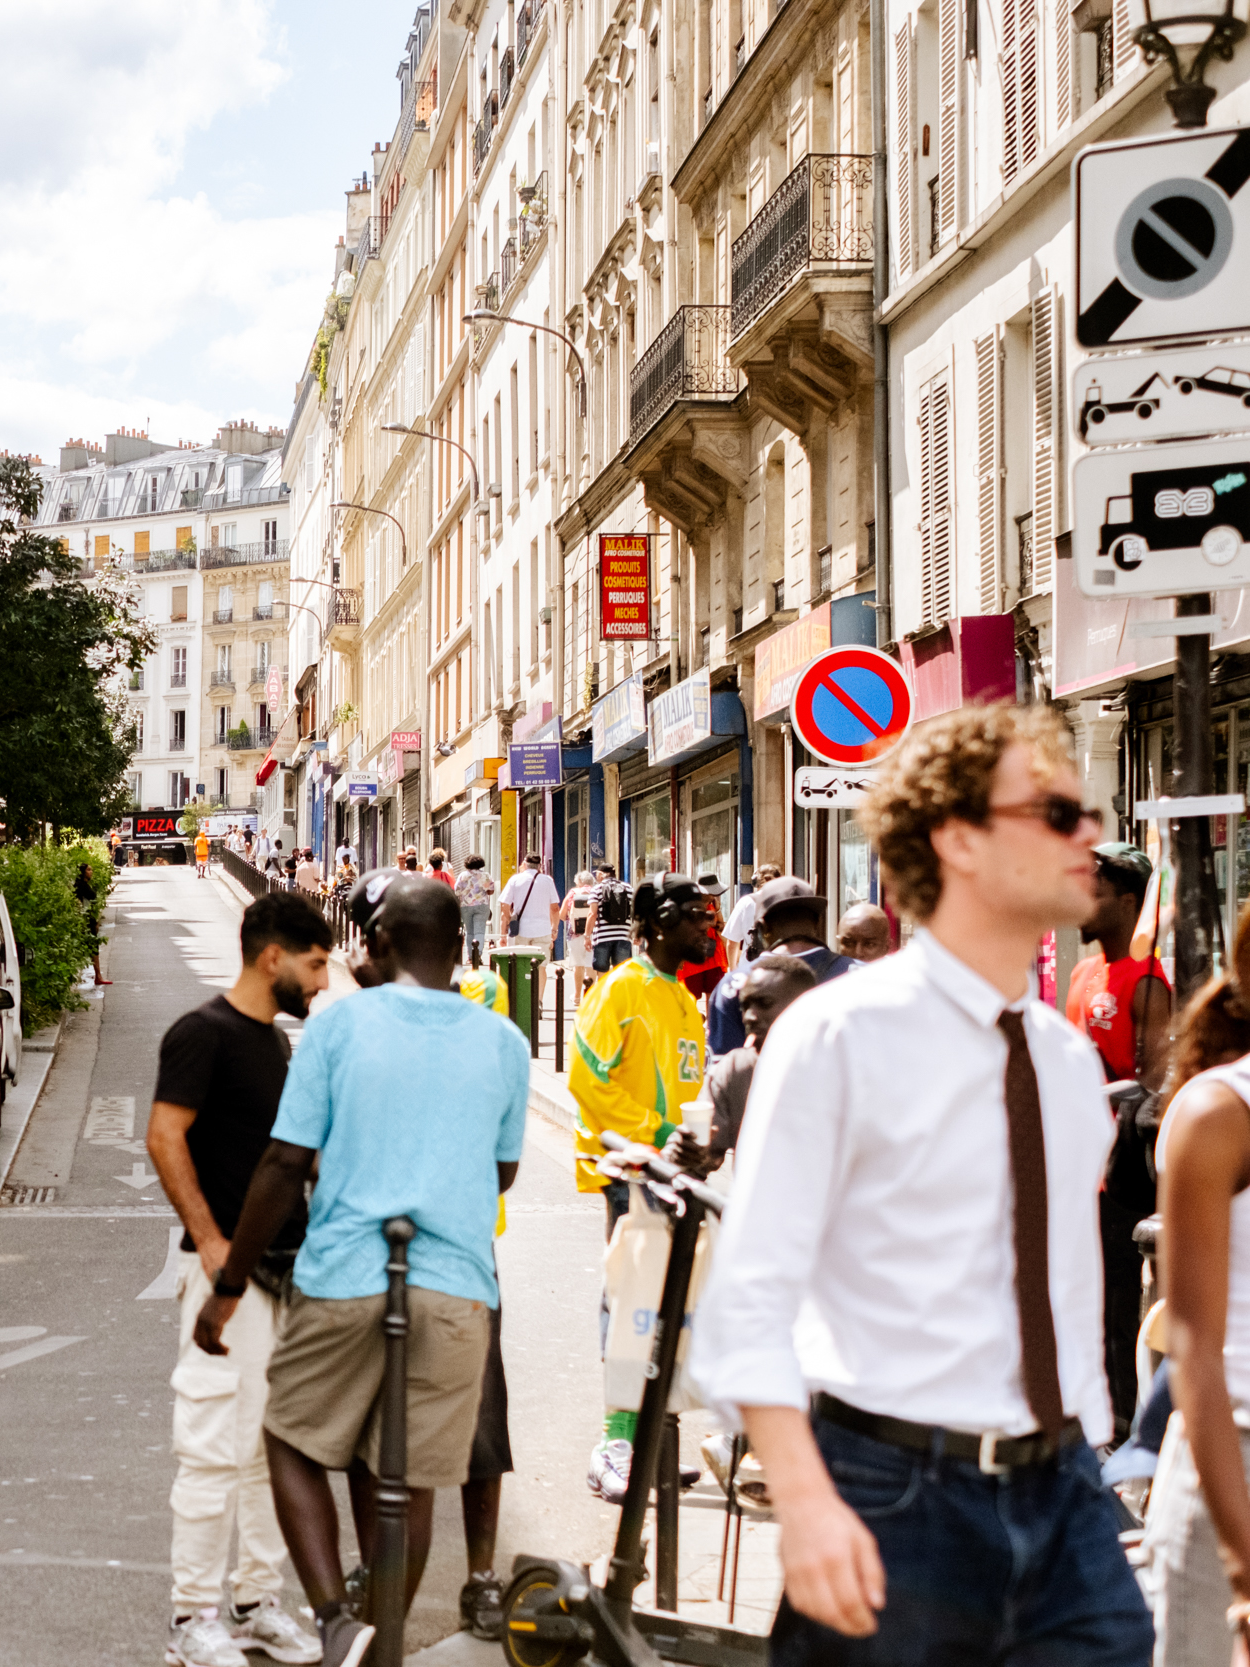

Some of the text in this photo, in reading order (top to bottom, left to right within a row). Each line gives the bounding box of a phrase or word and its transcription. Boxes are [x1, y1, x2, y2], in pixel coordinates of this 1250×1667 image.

[605, 539, 645, 550] MALIK
[610, 561, 641, 573] PRODUITS
[604, 576, 647, 588] COSMETIQUES
[608, 591, 645, 604] PERRUQUES
[614, 607, 639, 619] MECHES
[606, 622, 647, 635] ACCESSOIRES
[771, 620, 811, 680] MALIK
[270, 670, 278, 708] TABAC
[662, 683, 692, 729] MALIK
[392, 733, 418, 743] ADJA
[137, 818, 175, 832] PIZZA
